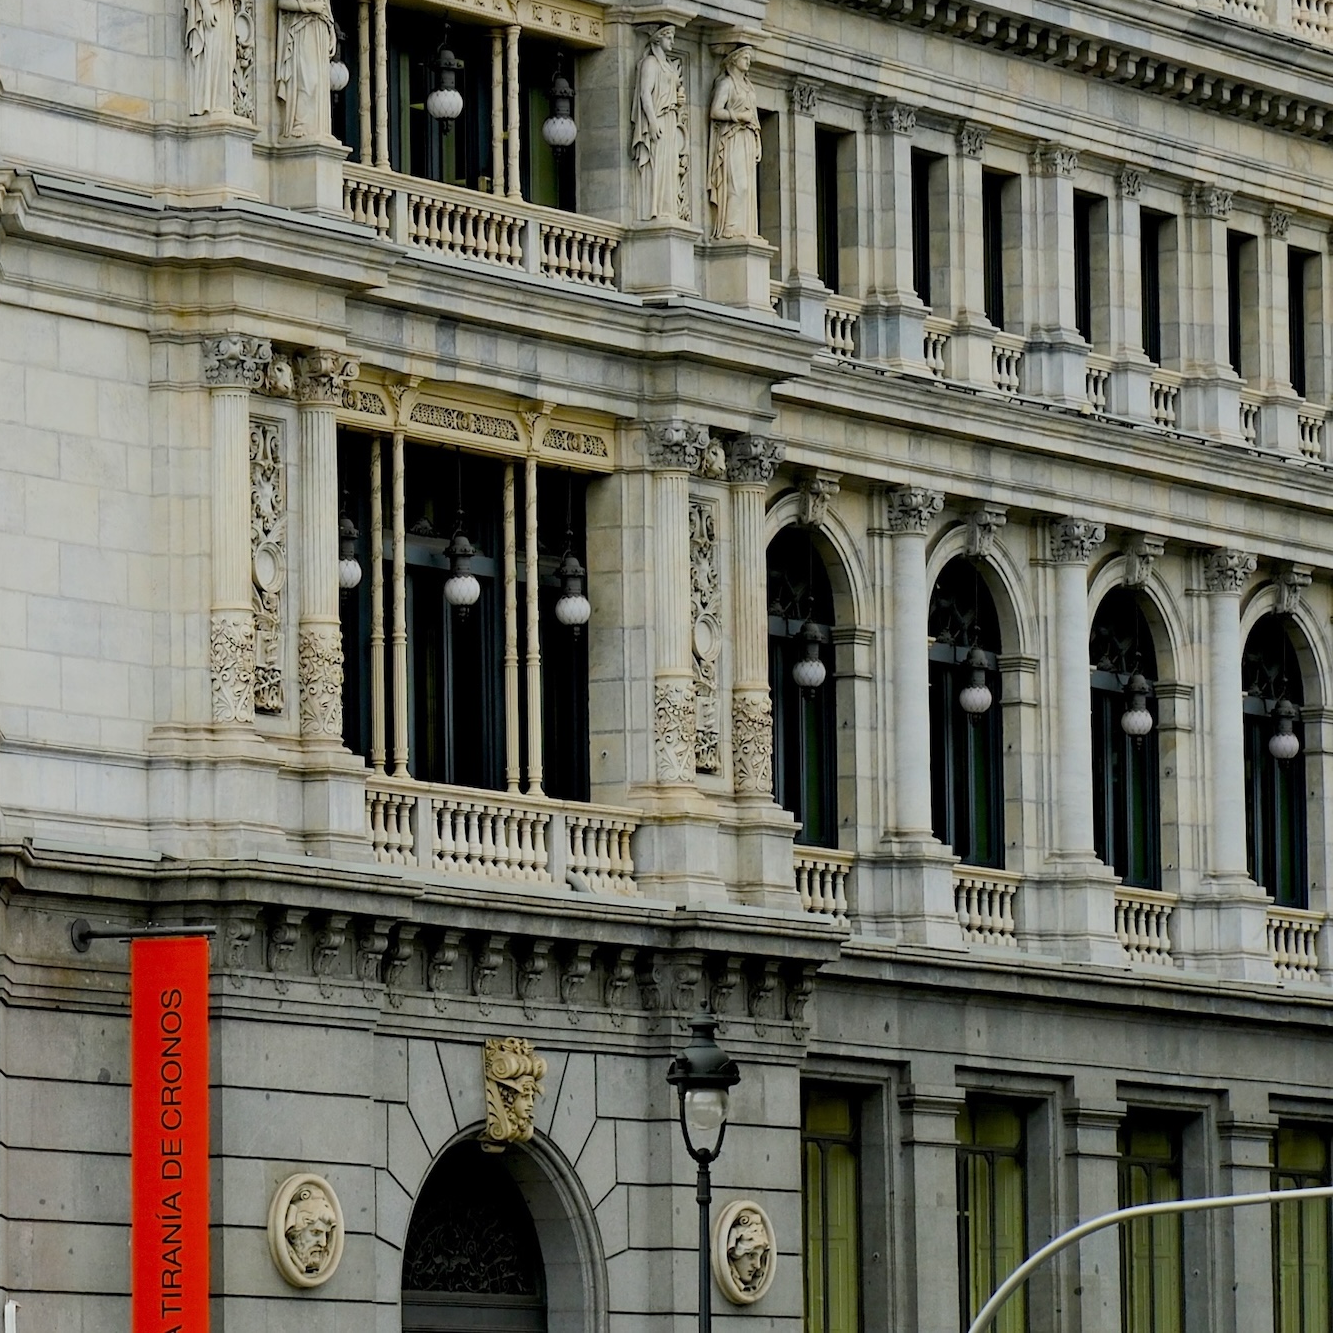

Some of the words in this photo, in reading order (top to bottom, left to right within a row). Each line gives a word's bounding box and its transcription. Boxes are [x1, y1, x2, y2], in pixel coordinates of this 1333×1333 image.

[161, 988, 183, 1131] CRONOS
[161, 1138, 182, 1180] DE
[155, 1190, 182, 1320] TIRANÍA
